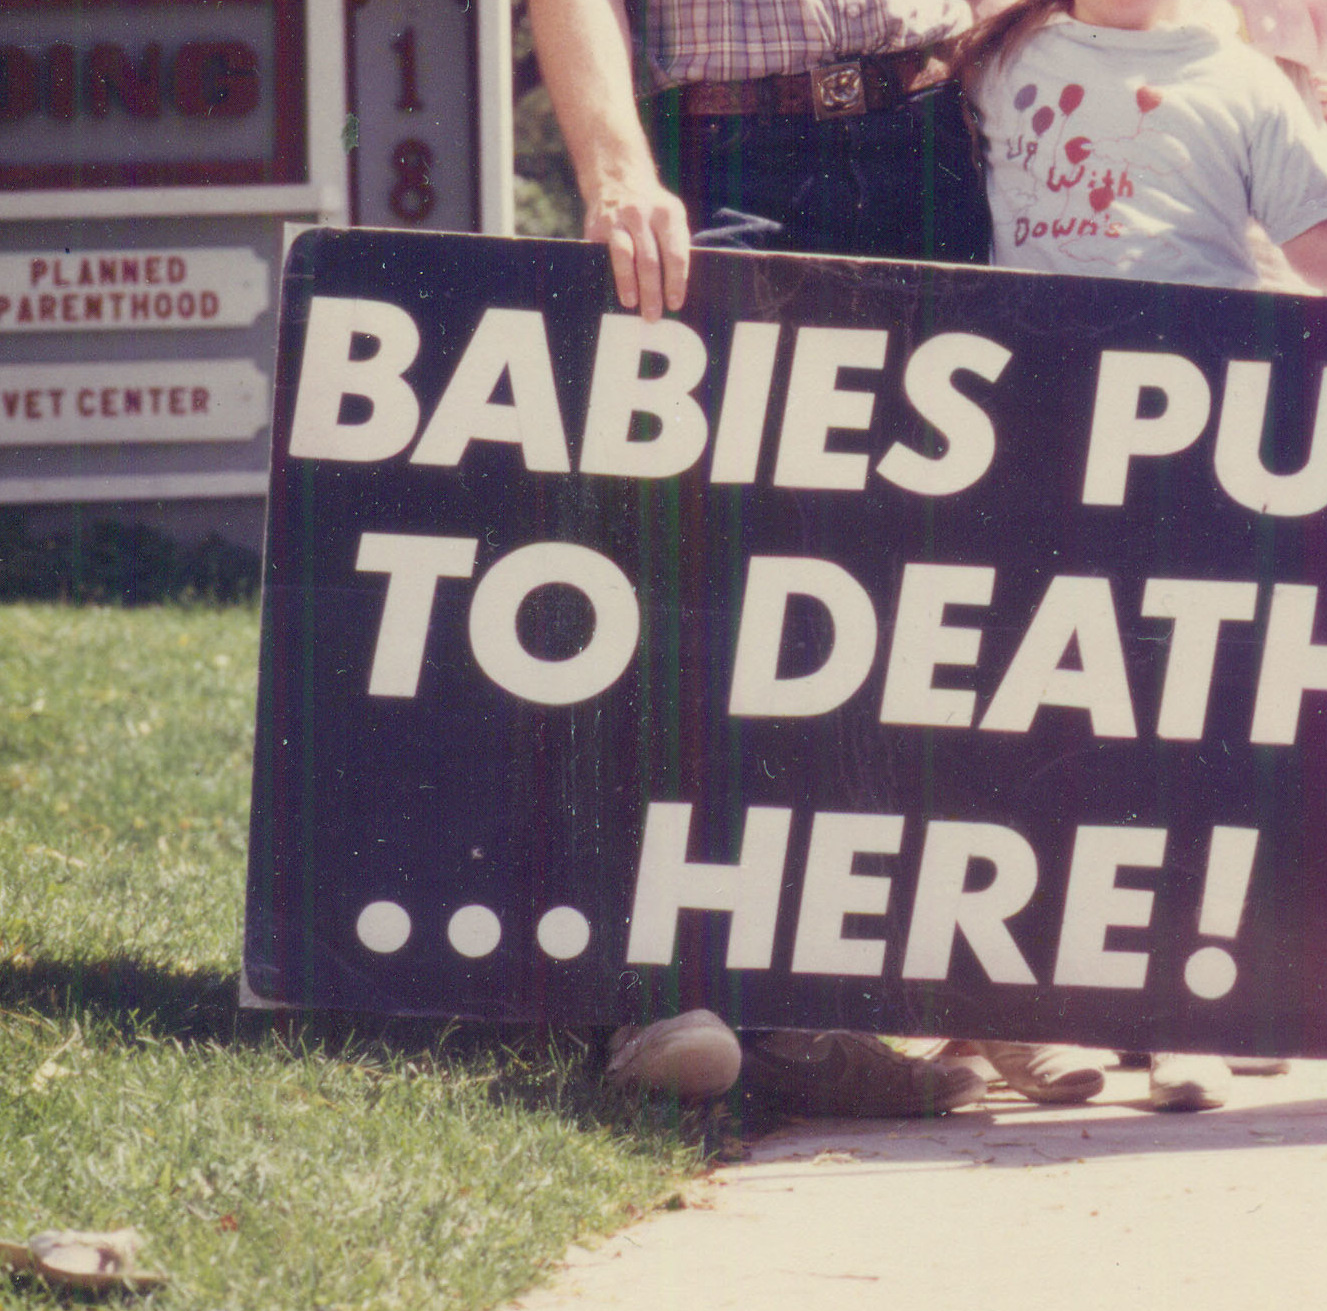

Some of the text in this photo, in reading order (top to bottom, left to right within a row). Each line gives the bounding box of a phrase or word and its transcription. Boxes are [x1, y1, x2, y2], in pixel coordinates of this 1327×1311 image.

[1014, 213, 1123, 247] Down's
[30, 255, 188, 287] PLANNED
[0, 290, 220, 323] PARENTHOOD
[2, 386, 209, 420] VET CENTER
[288, 296, 1012, 496] BABIES
[354, 531, 640, 706] TO
